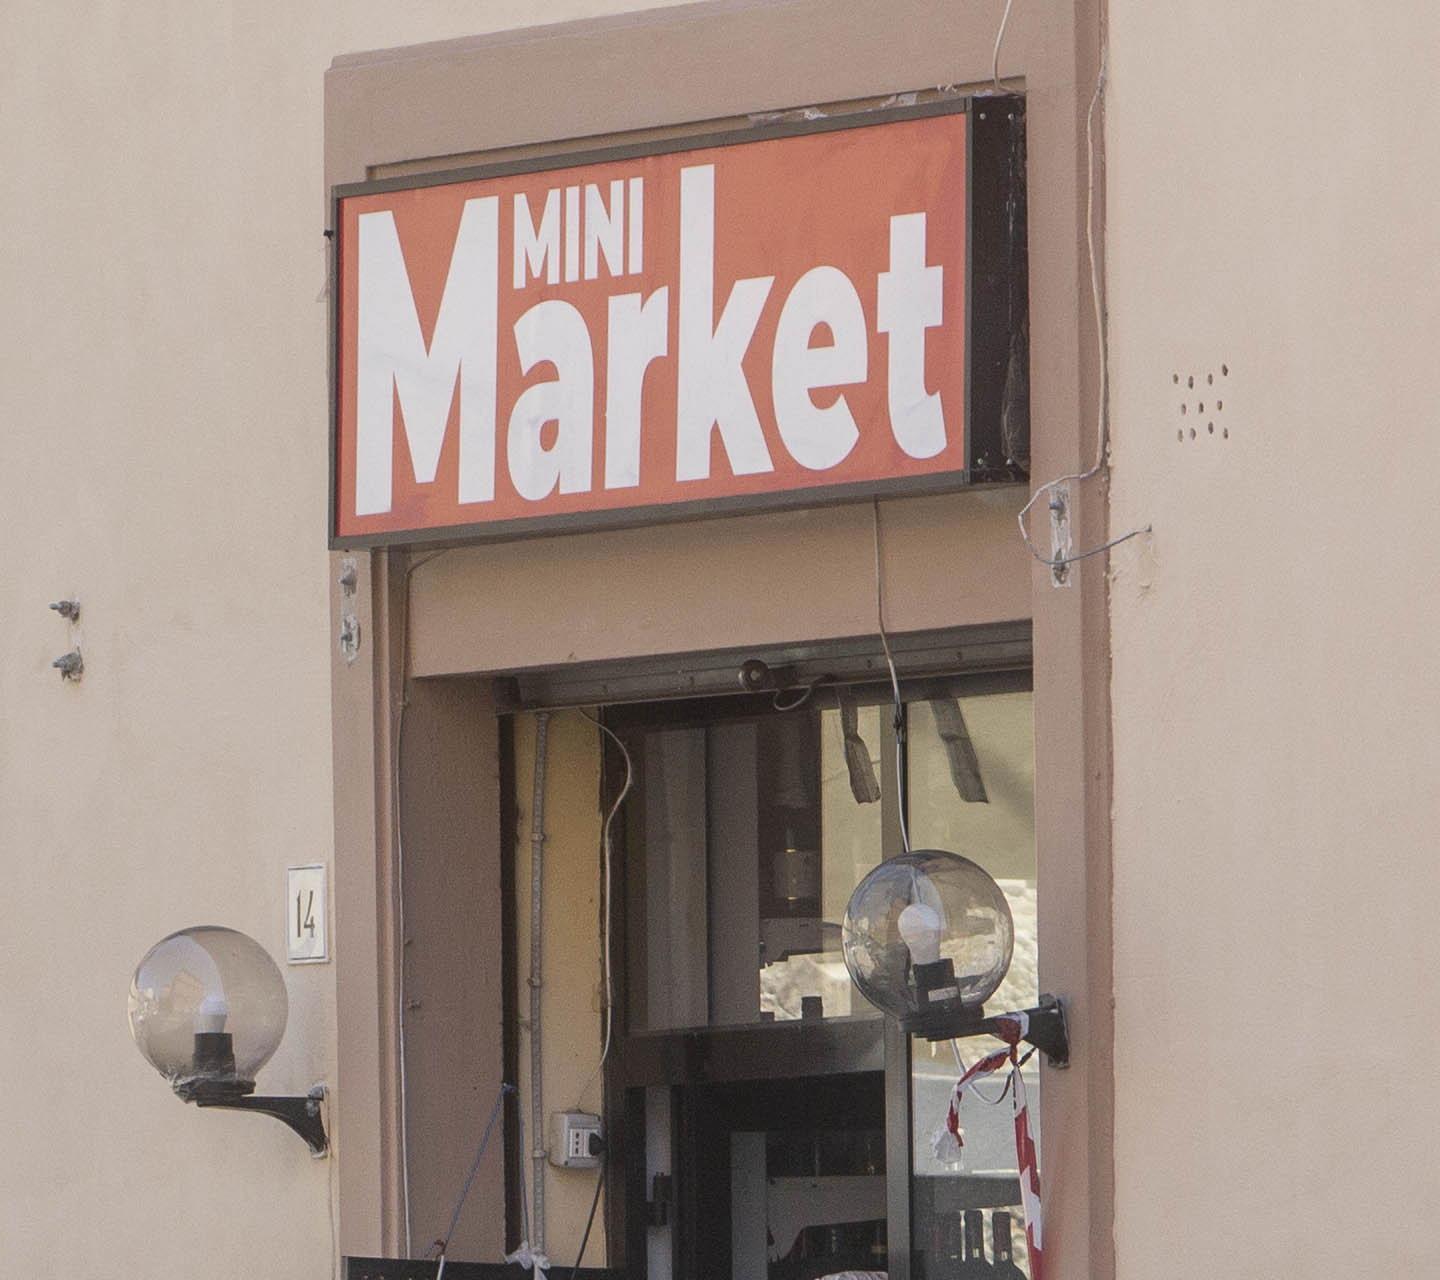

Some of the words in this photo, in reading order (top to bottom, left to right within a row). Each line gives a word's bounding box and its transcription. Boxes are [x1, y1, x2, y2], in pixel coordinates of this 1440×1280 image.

[513, 176, 643, 290] MINI
[355, 163, 948, 516] Market
[296, 889, 315, 938] 14
